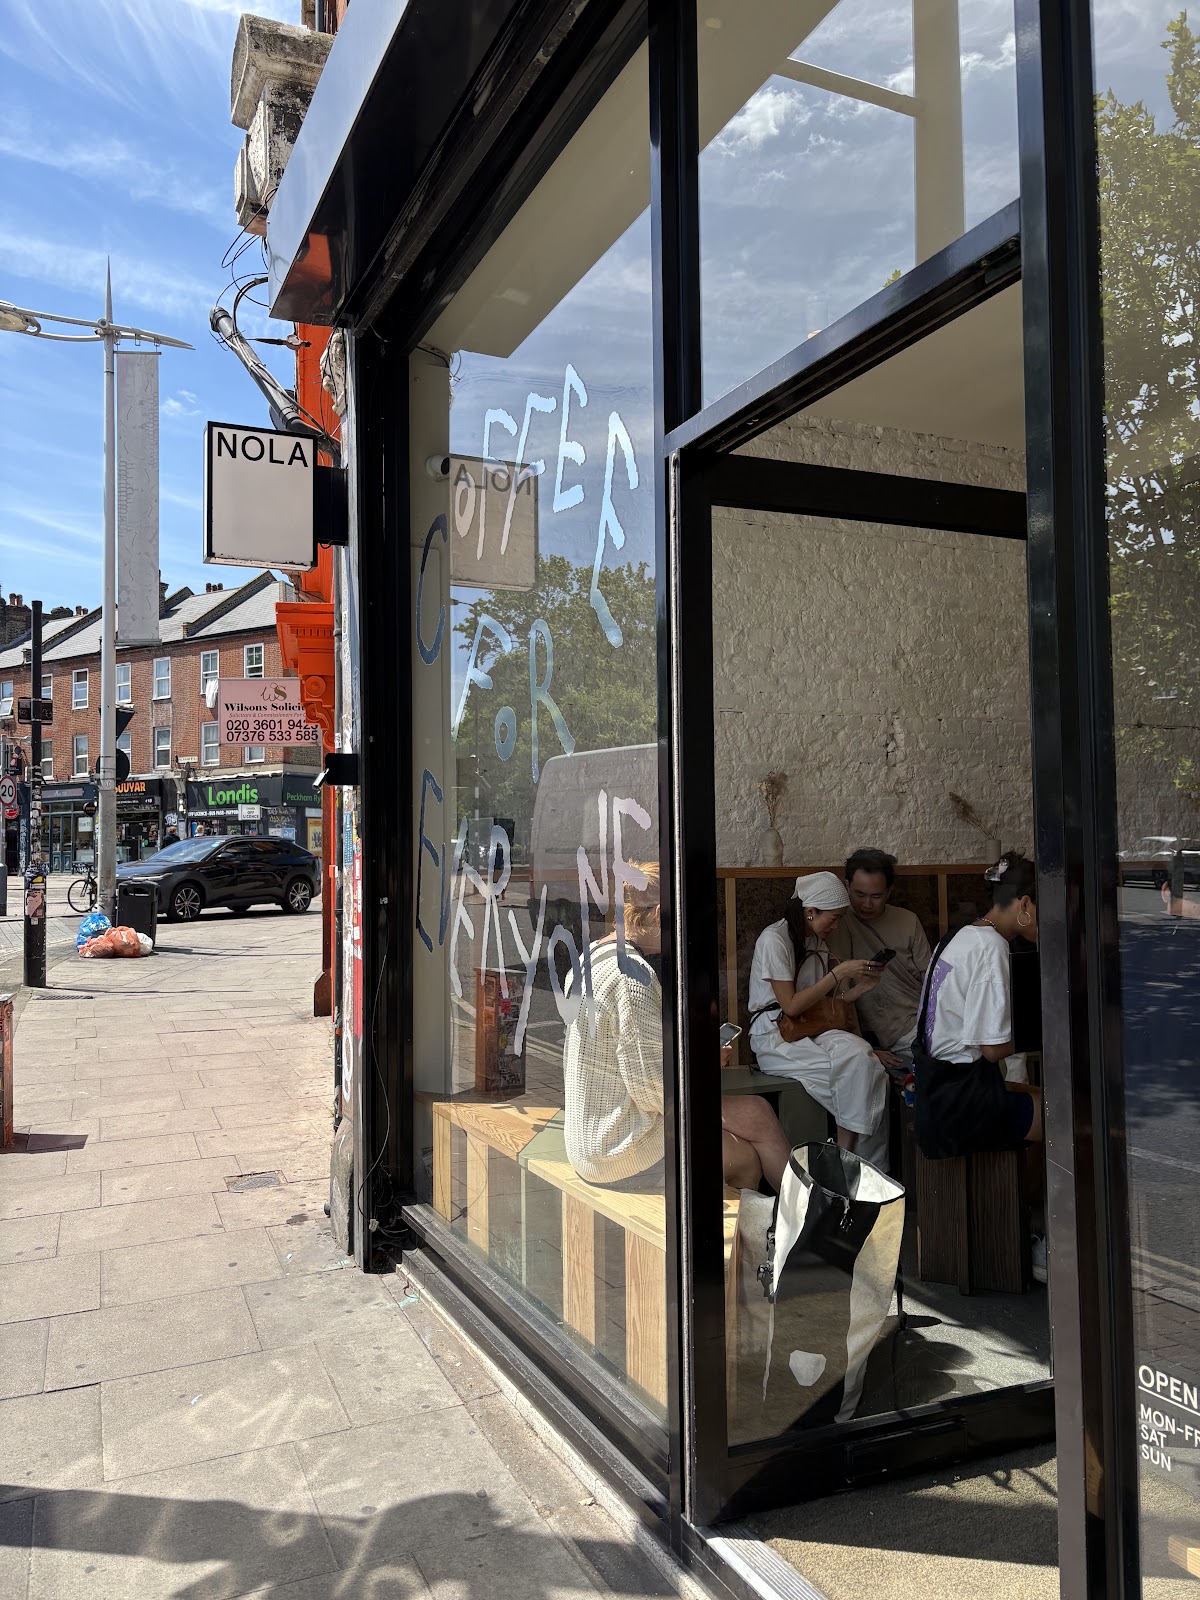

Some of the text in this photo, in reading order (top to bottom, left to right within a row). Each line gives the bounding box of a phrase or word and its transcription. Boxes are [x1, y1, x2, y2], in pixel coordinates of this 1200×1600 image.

[217, 431, 309, 468] NOLA
[416, 364, 639, 665] COFFEE
[224, 702, 268, 711] Wilsons
[453, 613, 576, 783] FOR
[226, 719, 250, 731] 020
[253, 719, 283, 730] 3601
[226, 730, 319, 742] 07376 533 585
[1, 784, 14, 798] 20
[208, 783, 259, 806] Londis
[286, 792, 321, 804] Peckham Ry
[415, 768, 652, 1057] EVERYONE
[1138, 1364, 1199, 1410] OPEN
[1140, 1424, 1167, 1448] SAT
[1141, 1443, 1172, 1472] SUN
